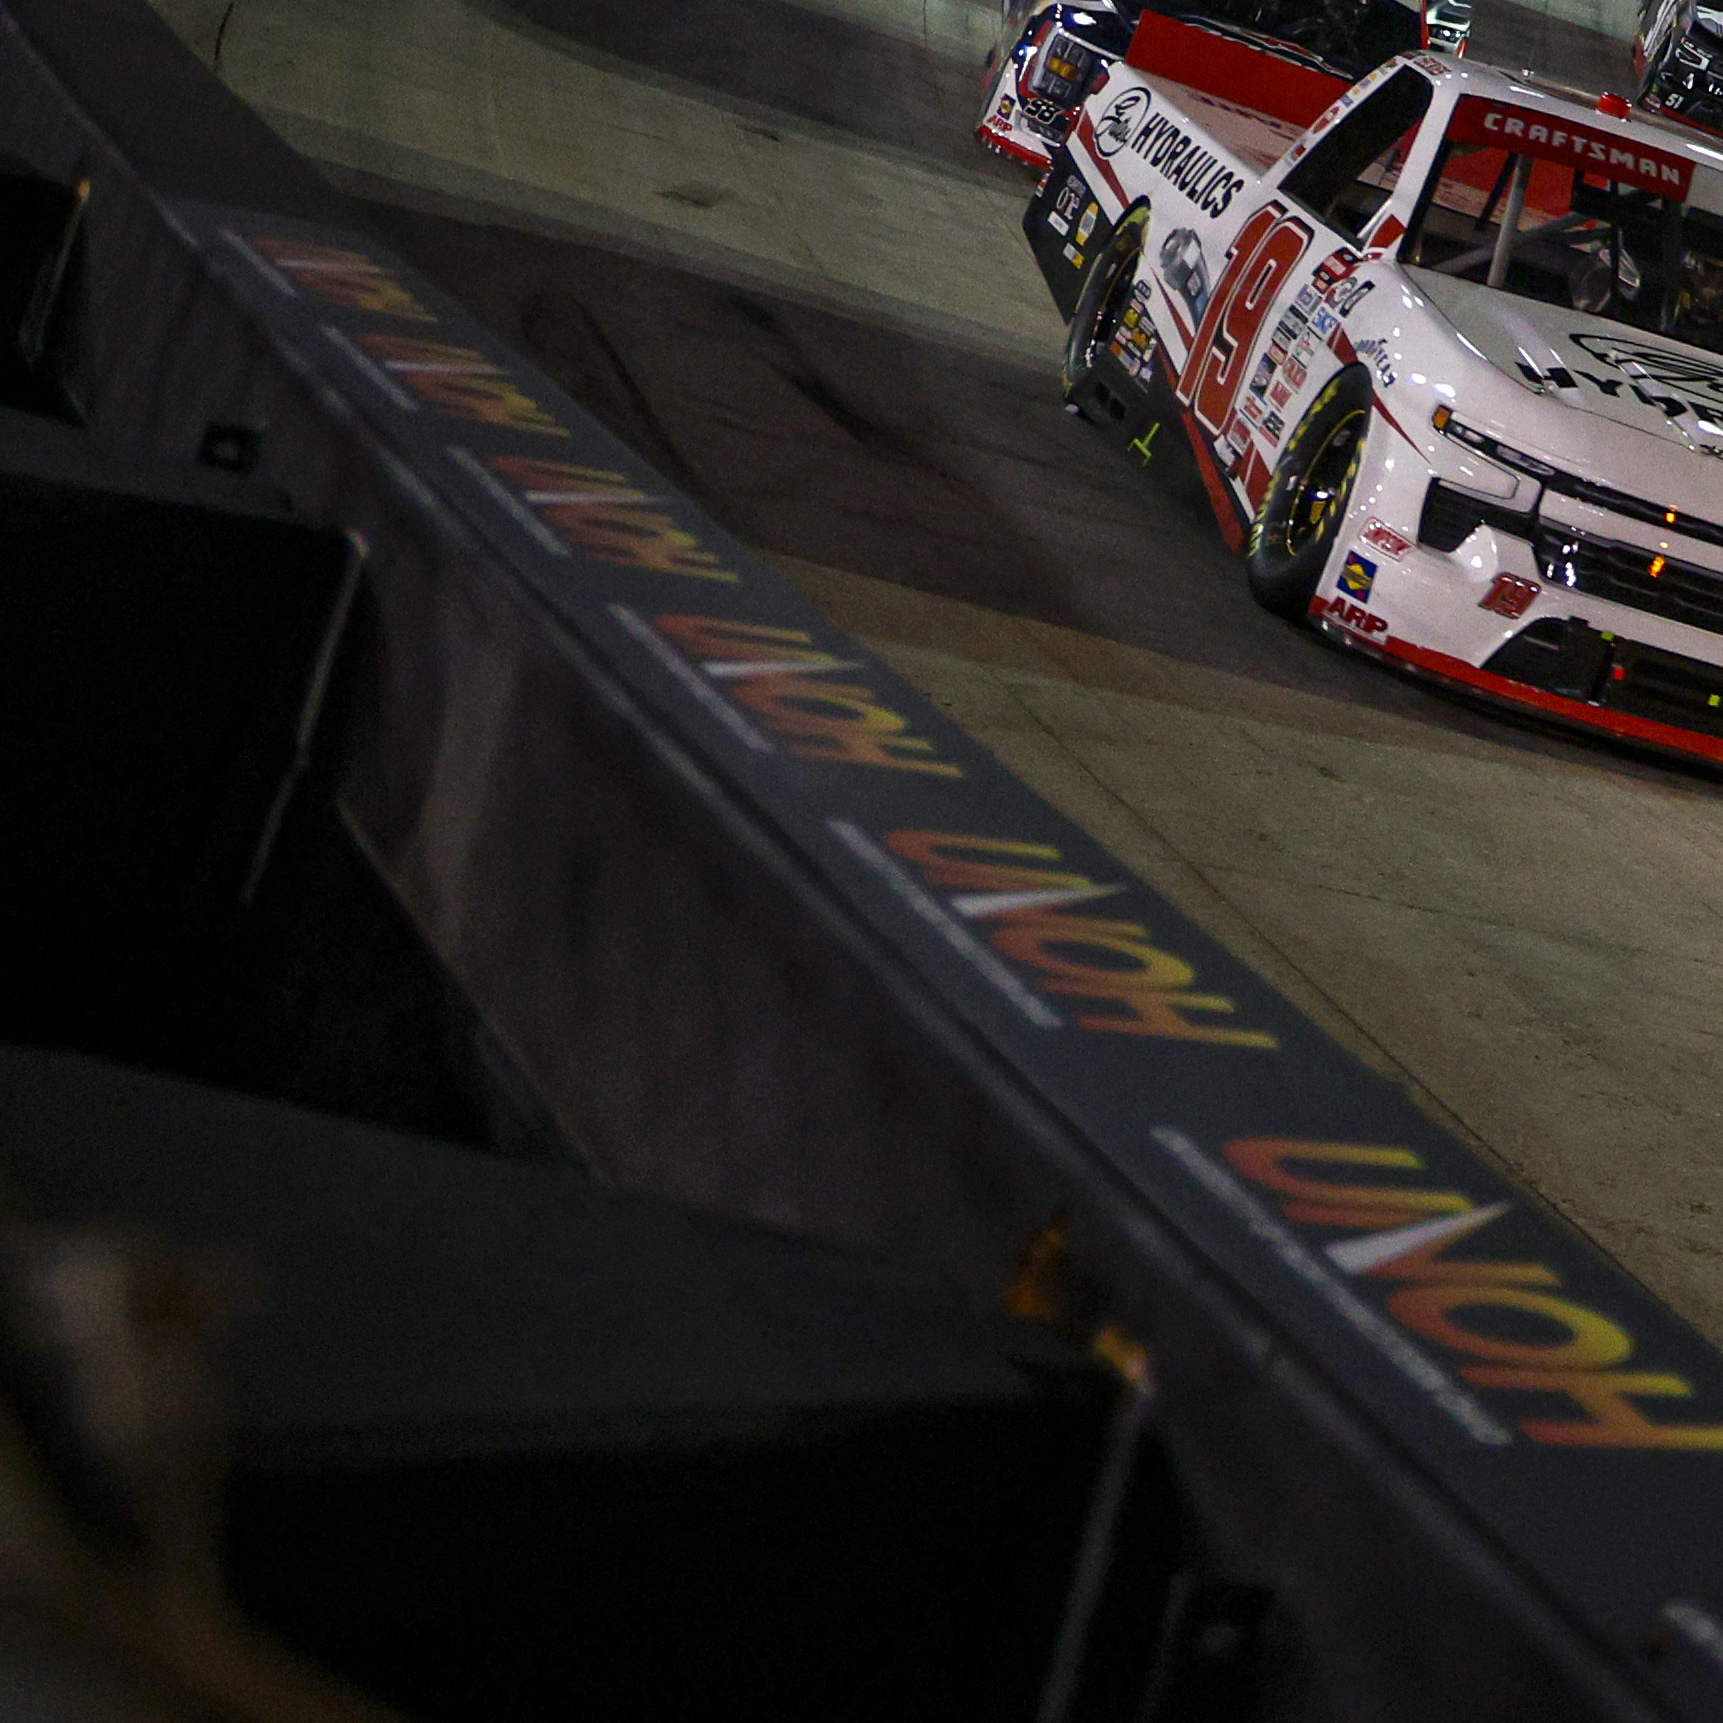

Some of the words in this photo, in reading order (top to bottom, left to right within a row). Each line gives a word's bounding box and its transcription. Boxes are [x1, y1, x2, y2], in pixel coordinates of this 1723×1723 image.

[986, 113, 1013, 132] ARP
[1023, 98, 1061, 124] 98
[1664, 92, 1685, 109] 51
[1130, 111, 1245, 220] HYDRAULICS
[1483, 110, 1683, 186] CRAFTSMAN
[1175, 197, 1316, 438] 19
[1326, 594, 1390, 637] ARP
[1479, 571, 1542, 621] 19
[884, 826, 1280, 1051] UNOH
